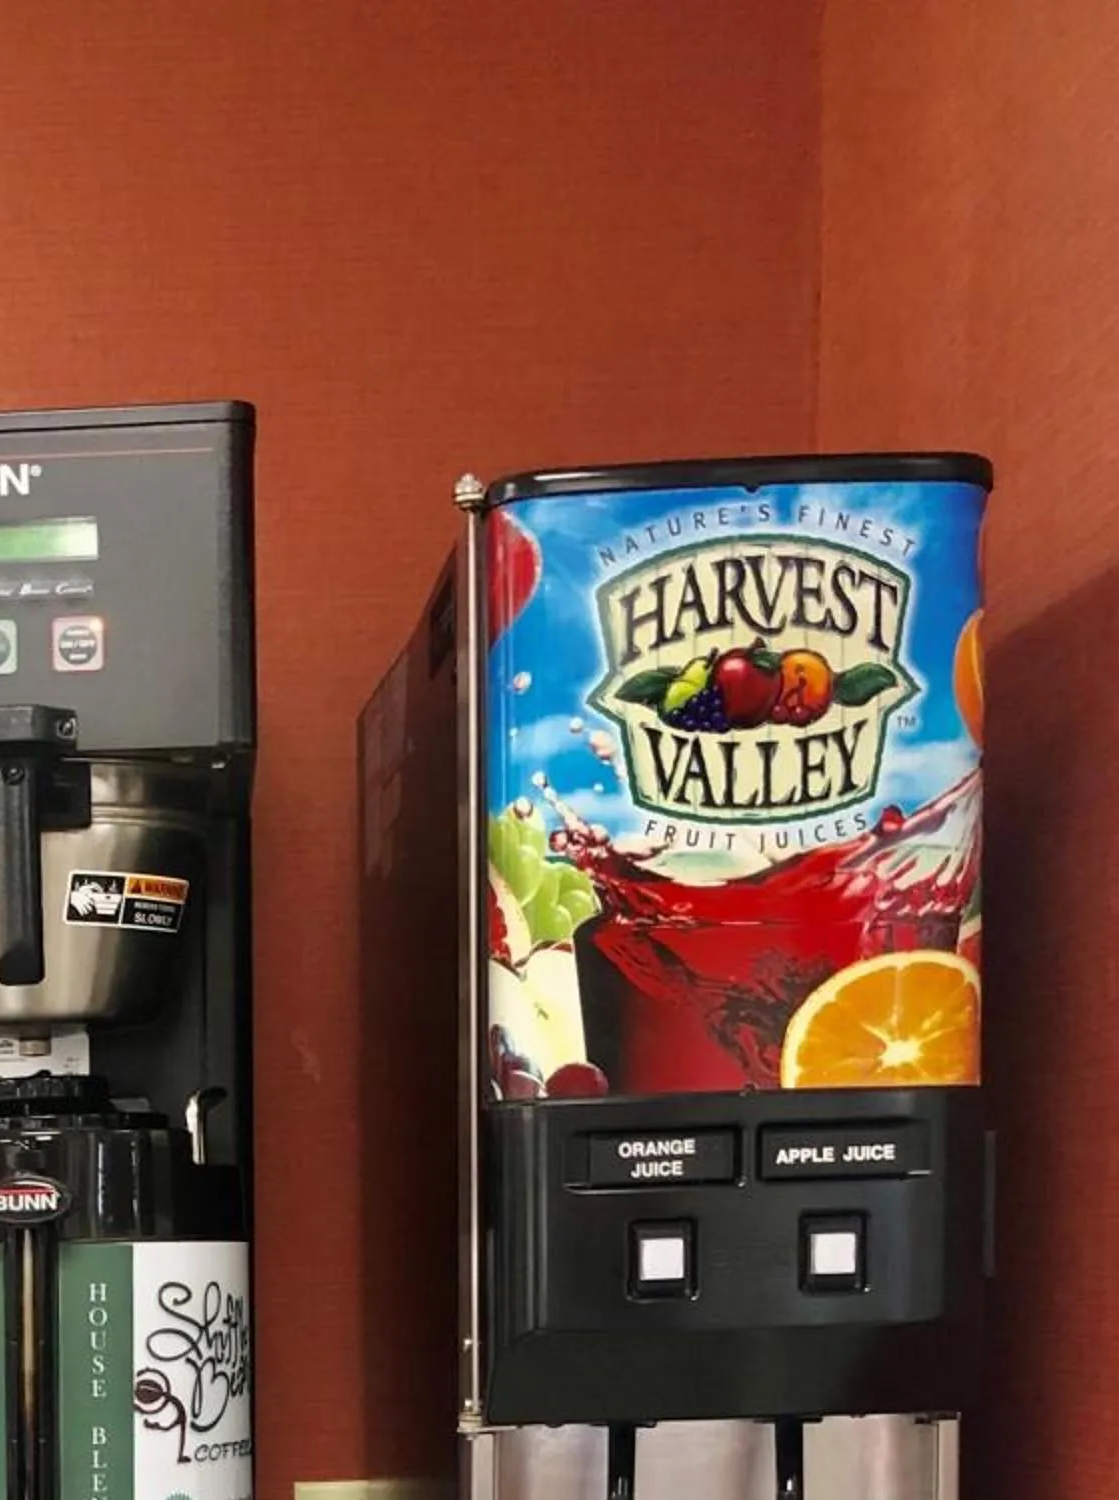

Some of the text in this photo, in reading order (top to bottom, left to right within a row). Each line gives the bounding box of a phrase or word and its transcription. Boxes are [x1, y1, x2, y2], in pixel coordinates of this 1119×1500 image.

[597, 504, 917, 567] NATURE'S FINEST
[616, 554, 899, 666] HARVEST
[643, 720, 869, 809] VALLEY
[644, 812, 868, 852] FRUIT JUICES
[618, 1139, 696, 1159] ORANGE
[631, 1160, 684, 1178] JUICE
[776, 1143, 896, 1164] APPLE JUICE
[88, 1282, 109, 1398] HOUSE
